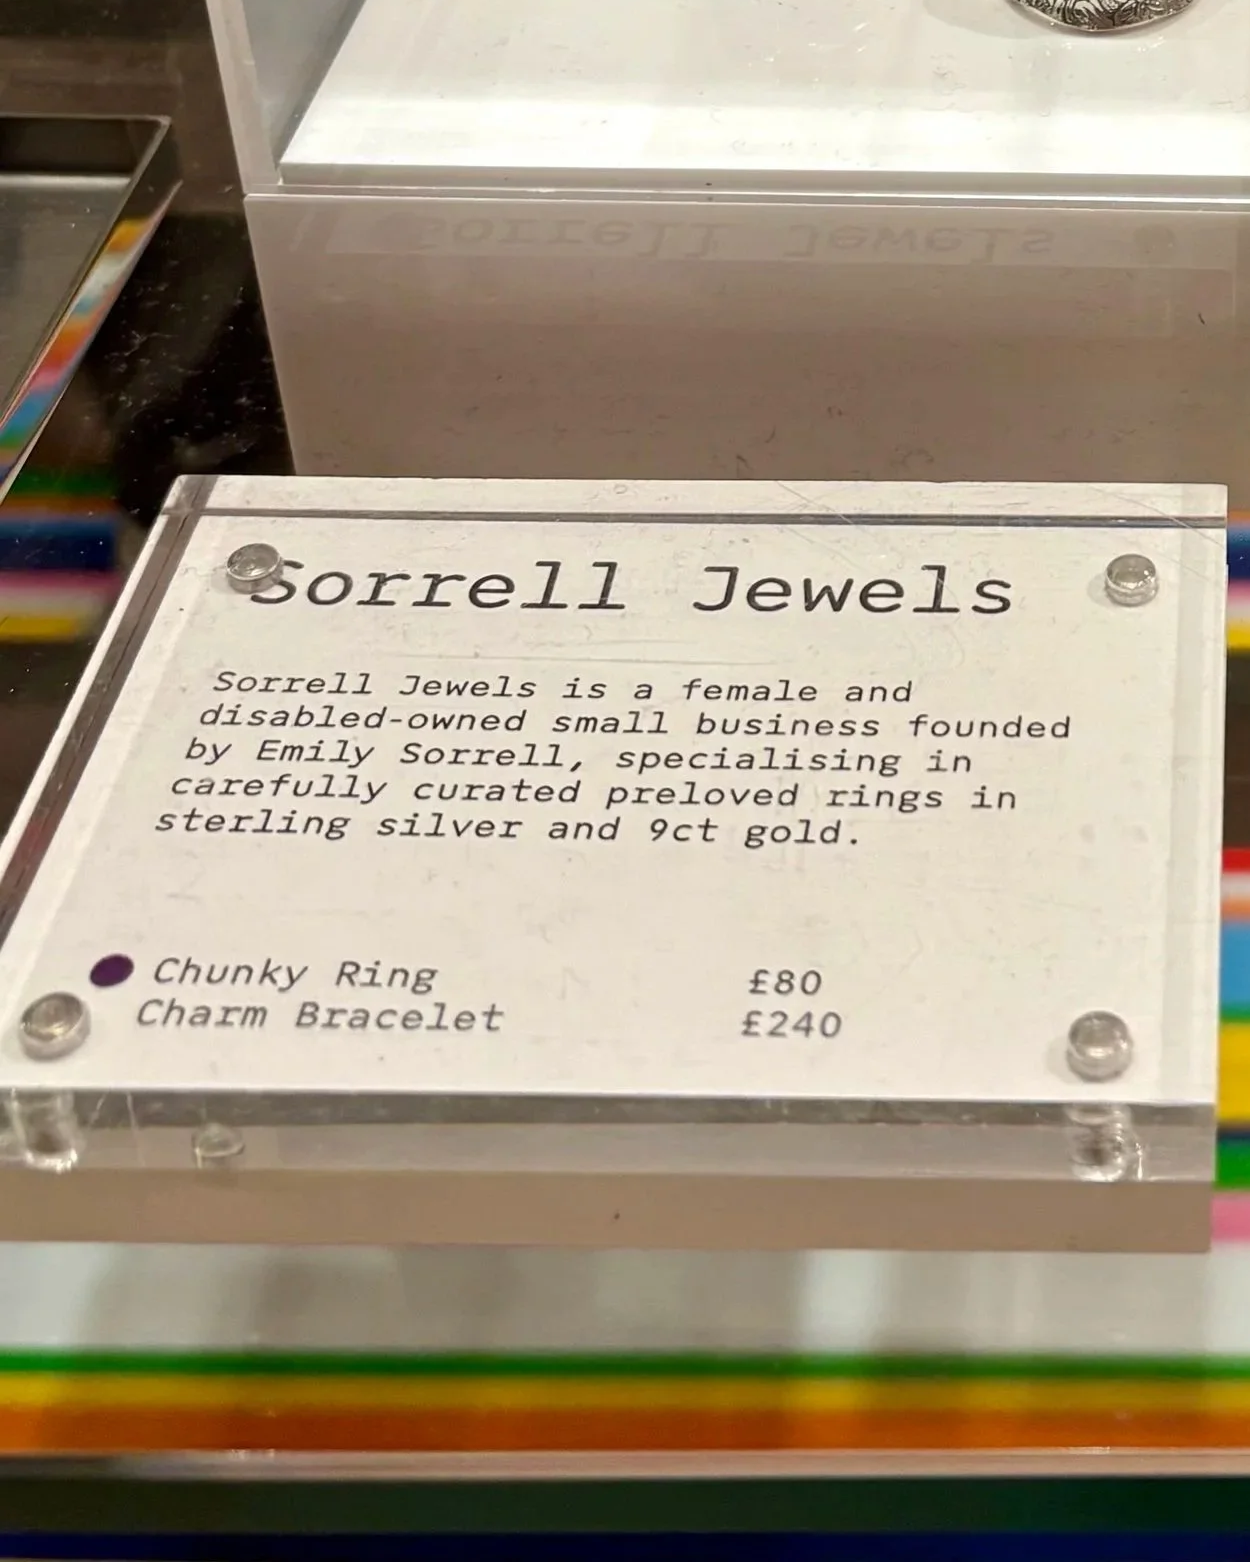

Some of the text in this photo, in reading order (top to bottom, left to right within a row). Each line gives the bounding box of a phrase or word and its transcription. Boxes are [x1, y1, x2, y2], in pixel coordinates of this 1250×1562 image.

[692, 564, 1012, 615] Jewels
[212, 670, 913, 703] Sorrell Jewels is a female and
[199, 702, 1071, 739] disabled-owned small business founded
[184, 736, 972, 778] by Emily Sorrell, specialising in
[171, 772, 1016, 814] carefully curated preloved rings in
[154, 807, 858, 850] sterling silver and 9ct gold.
[153, 956, 822, 996] Chunky Ring £80
[136, 997, 842, 1039] Charm Bracelet £240
